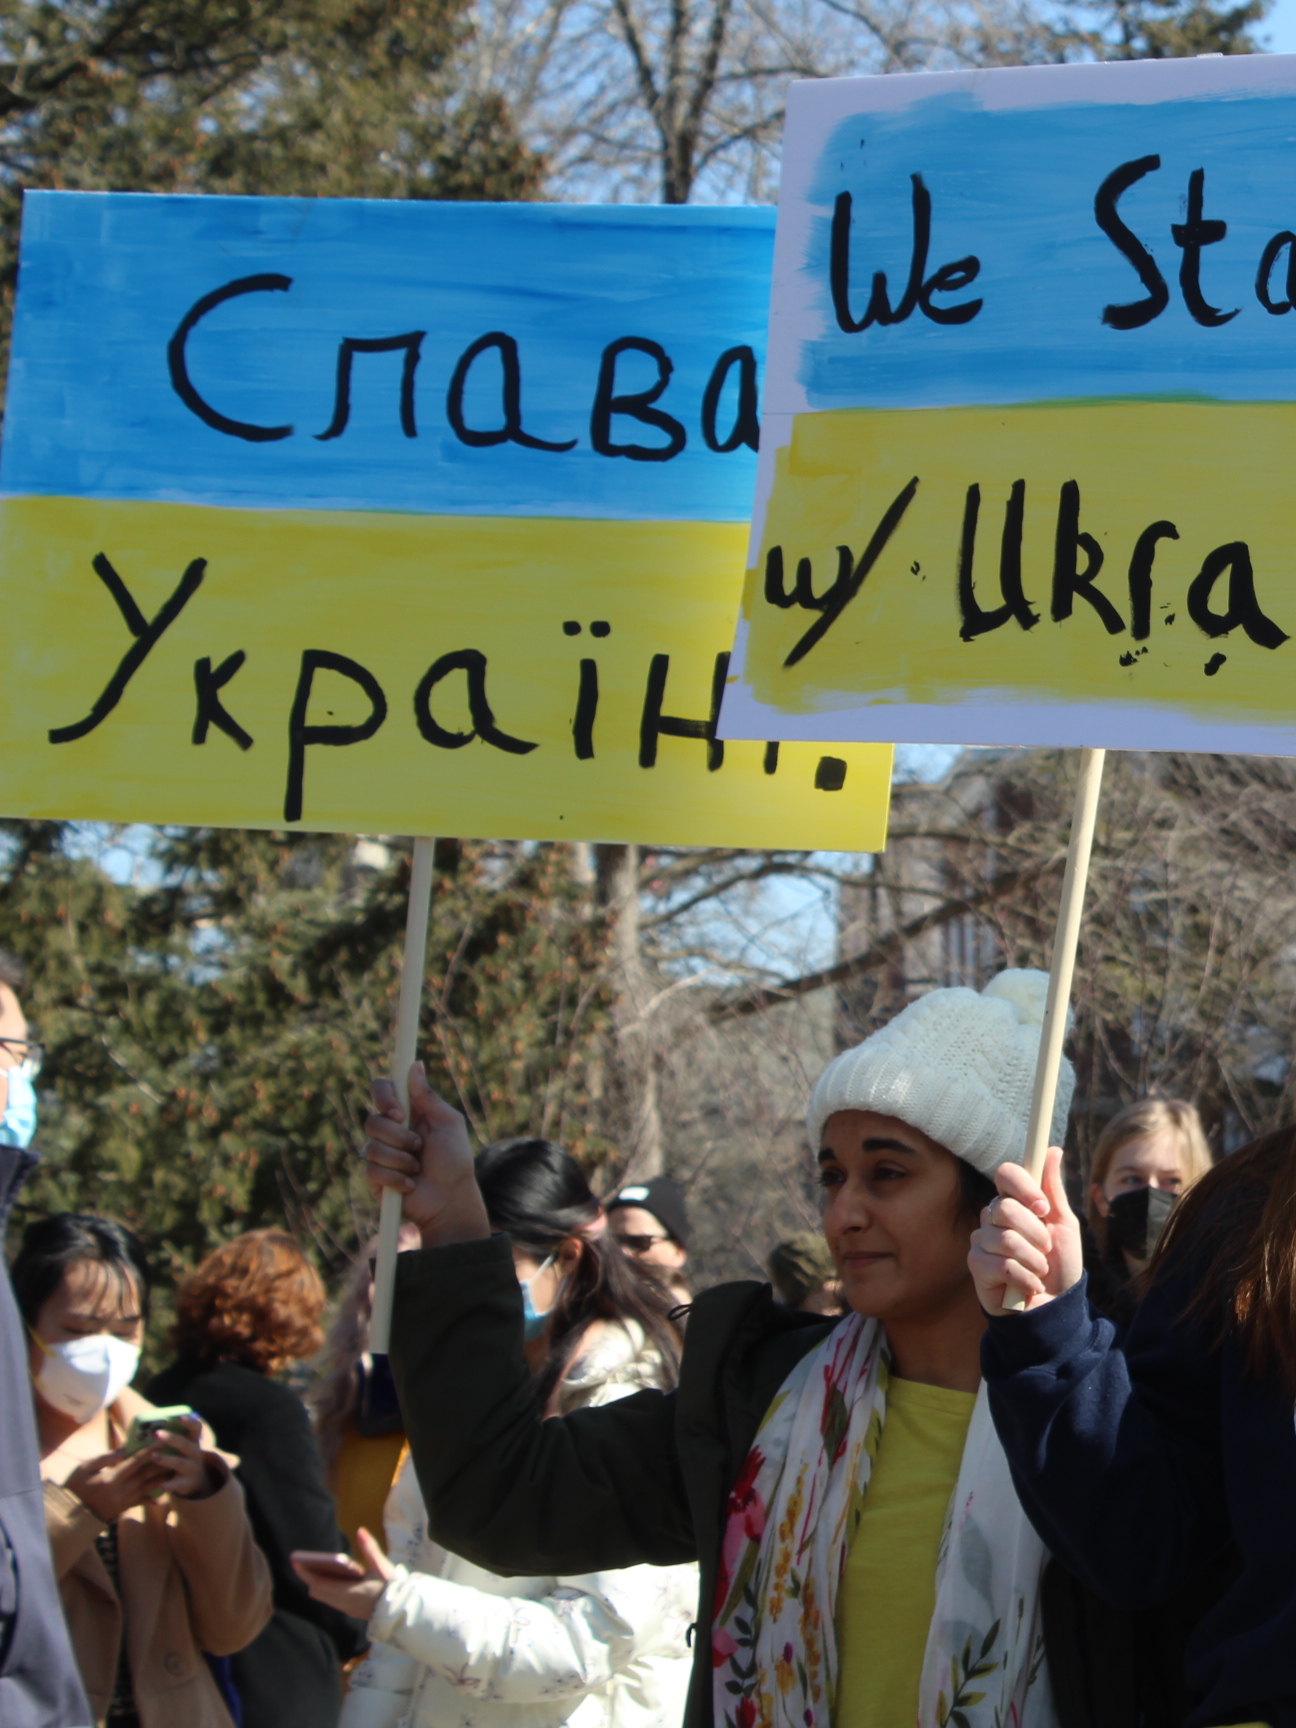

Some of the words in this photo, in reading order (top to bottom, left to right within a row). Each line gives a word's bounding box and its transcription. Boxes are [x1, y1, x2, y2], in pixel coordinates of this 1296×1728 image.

[829, 172, 984, 334] We
[168, 272, 760, 462] Слава
[764, 475, 919, 671] w/
